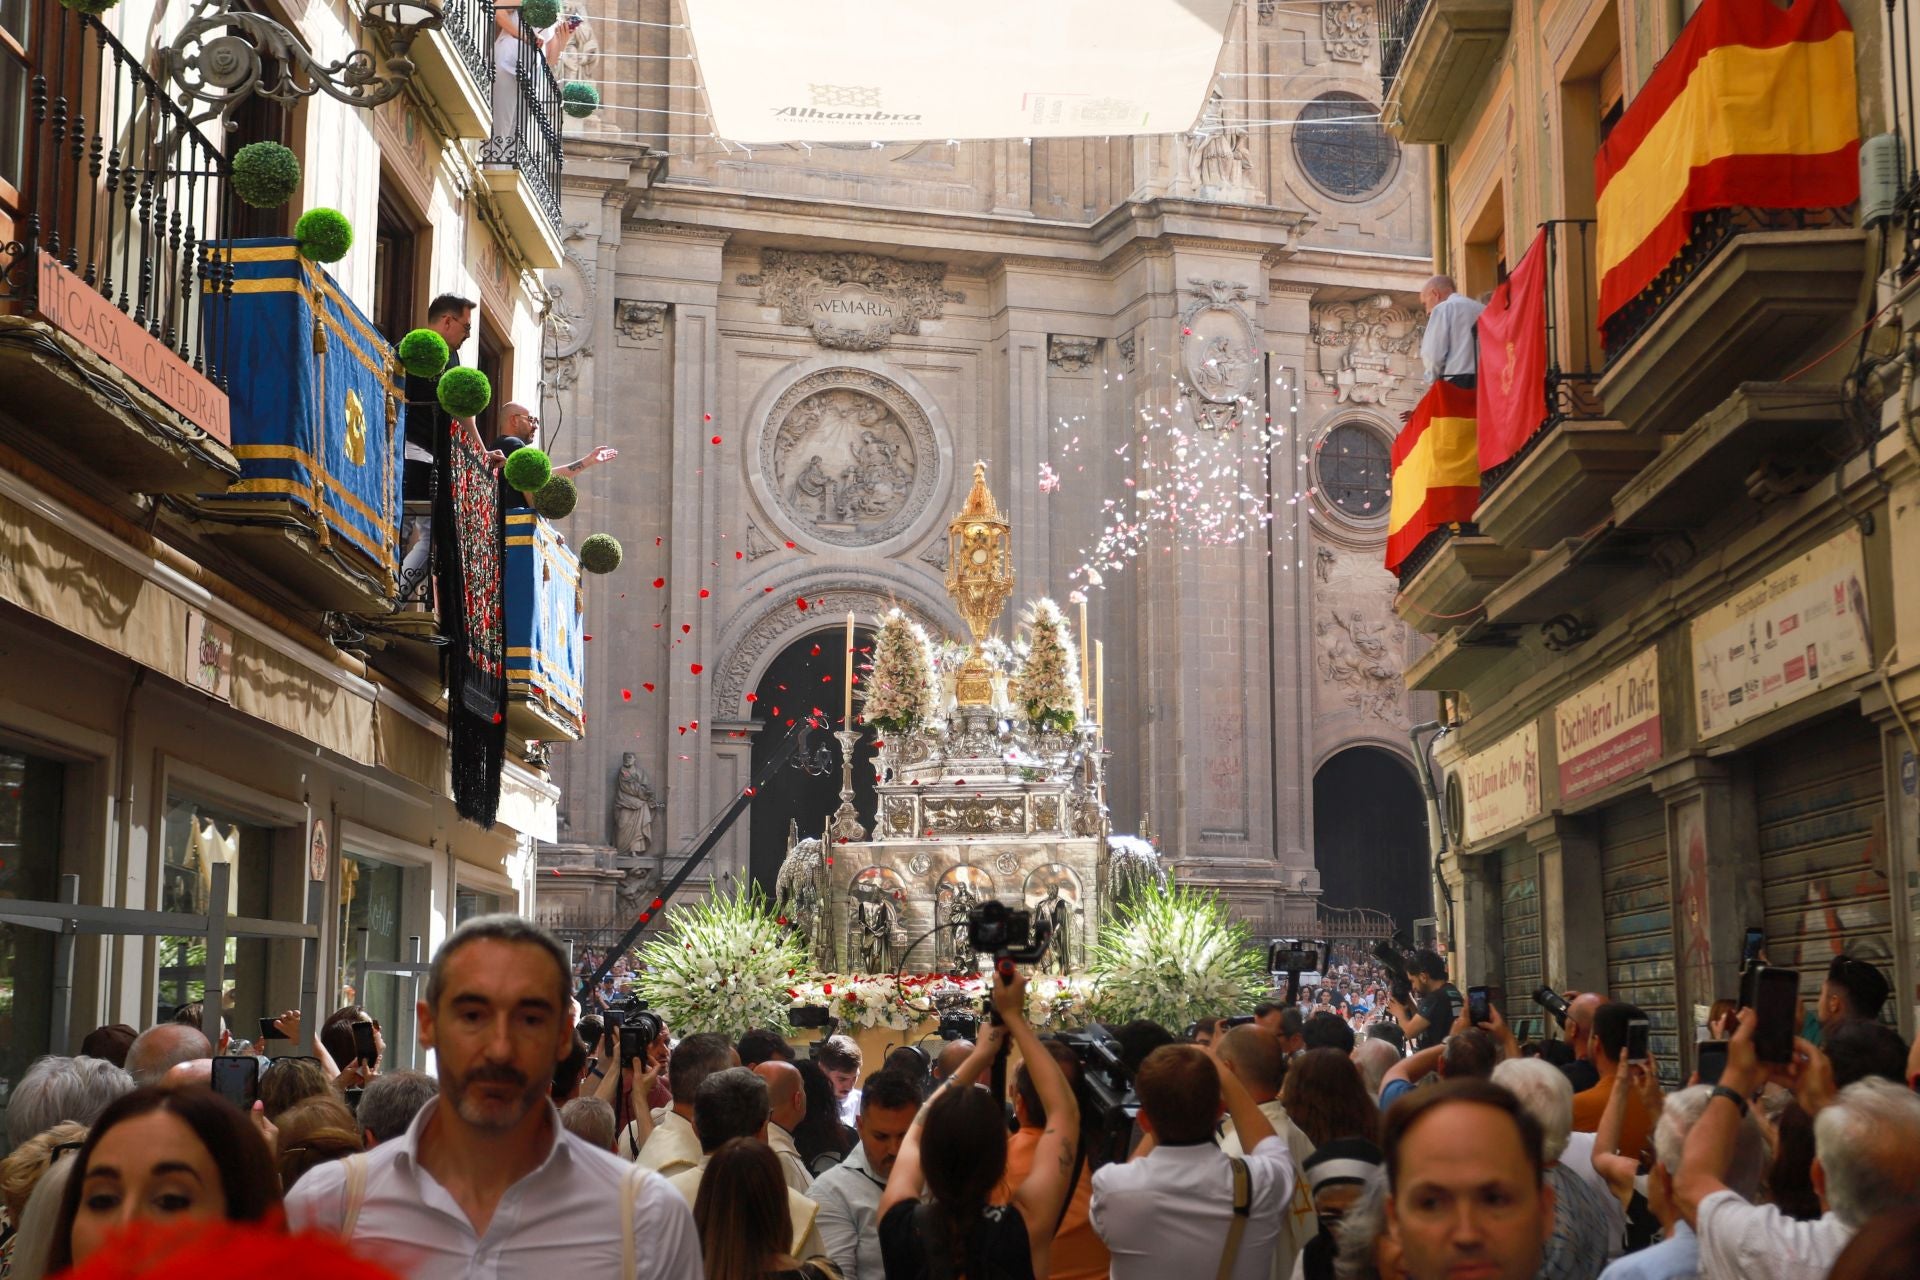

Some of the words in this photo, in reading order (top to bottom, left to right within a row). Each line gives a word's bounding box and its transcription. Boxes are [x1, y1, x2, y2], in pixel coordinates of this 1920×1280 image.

[769, 106, 922, 121] Alhambra
[67, 291, 123, 361] CASA
[144, 343, 226, 436] CATEDRAL
